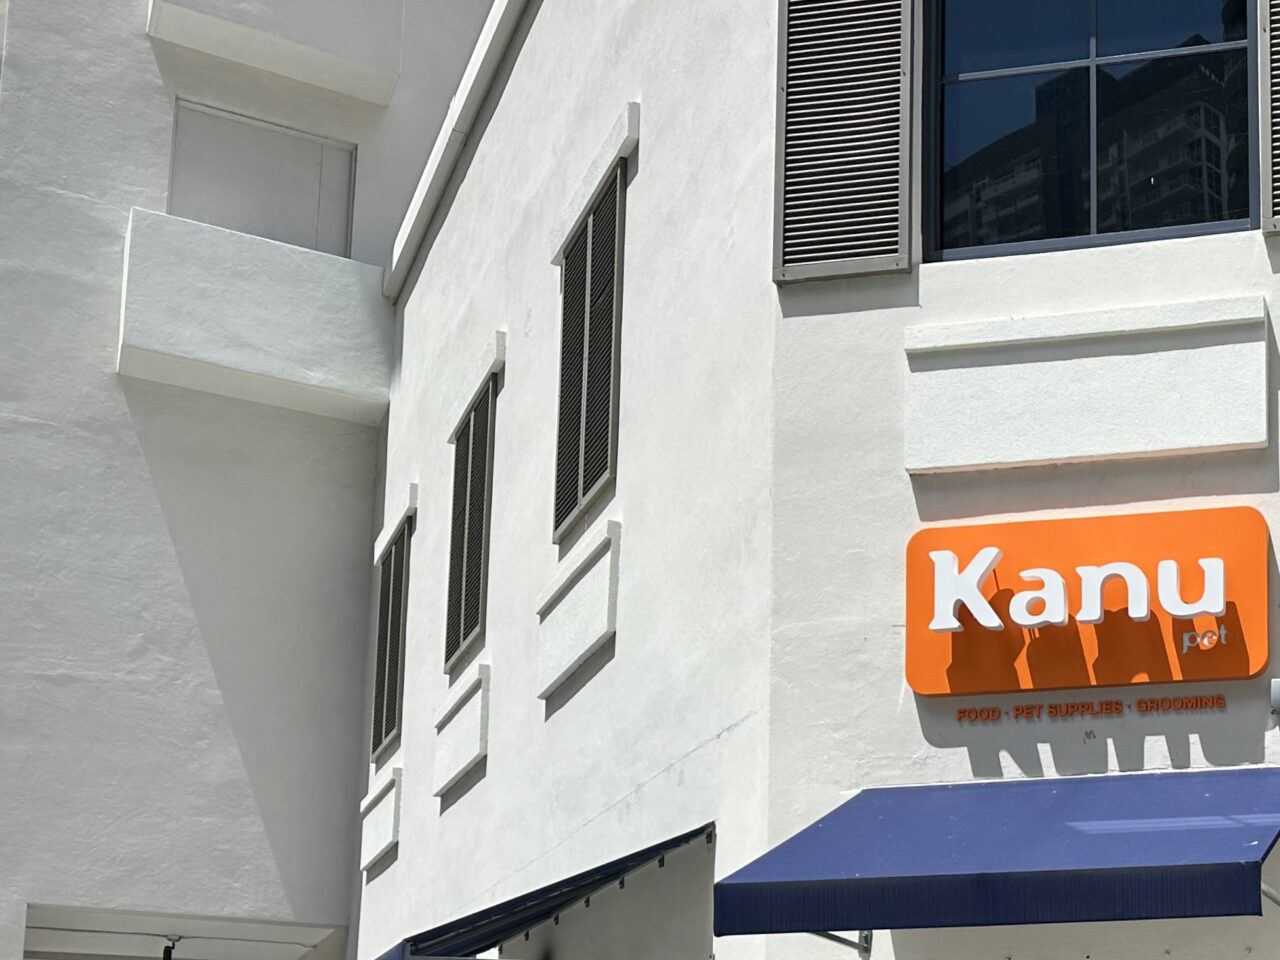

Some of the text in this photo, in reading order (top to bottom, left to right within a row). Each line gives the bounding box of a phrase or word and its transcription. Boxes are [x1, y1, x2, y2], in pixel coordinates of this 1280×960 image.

[928, 546, 1227, 632] Kanu
[1181, 623, 1228, 654] pet
[956, 694, 1226, 722] FOOD PET SUPPLIES GROOMING
